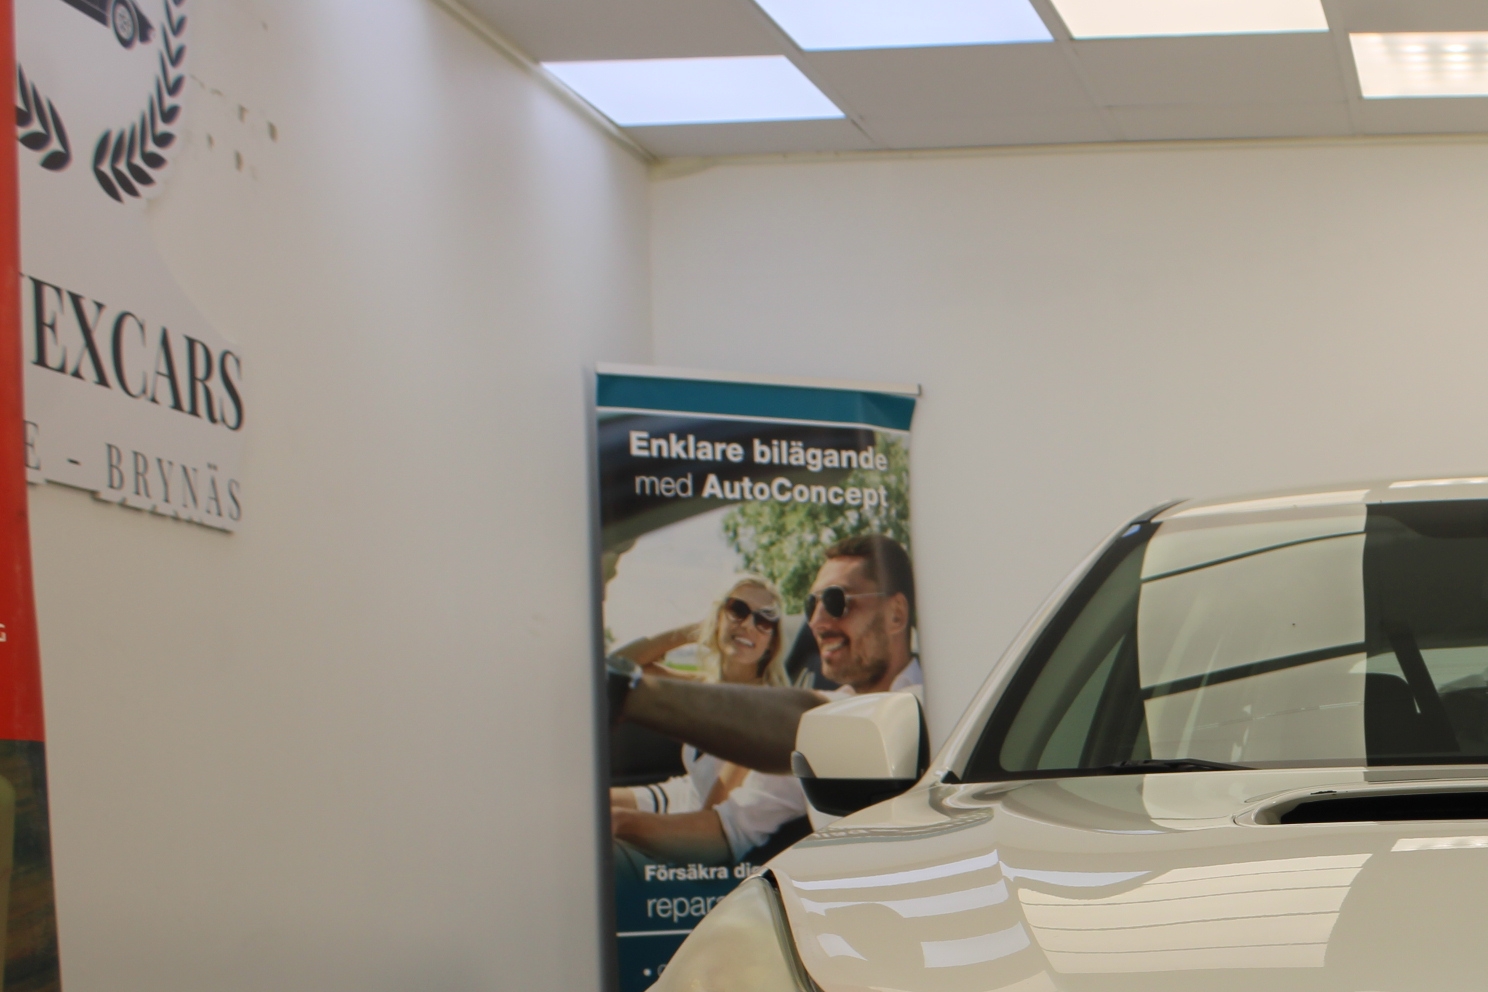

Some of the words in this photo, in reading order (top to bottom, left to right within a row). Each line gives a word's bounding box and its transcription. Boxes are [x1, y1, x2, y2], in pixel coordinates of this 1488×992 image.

[20, 273, 245, 431] EXCARS
[629, 430, 744, 463] Enklare
[752, 437, 888, 472] bilägande
[105, 441, 242, 522] BRYNÄS
[635, 473, 693, 497] med
[702, 474, 888, 507] AutoConcept
[644, 864, 729, 881] Försäkra
[647, 895, 726, 923] repar
